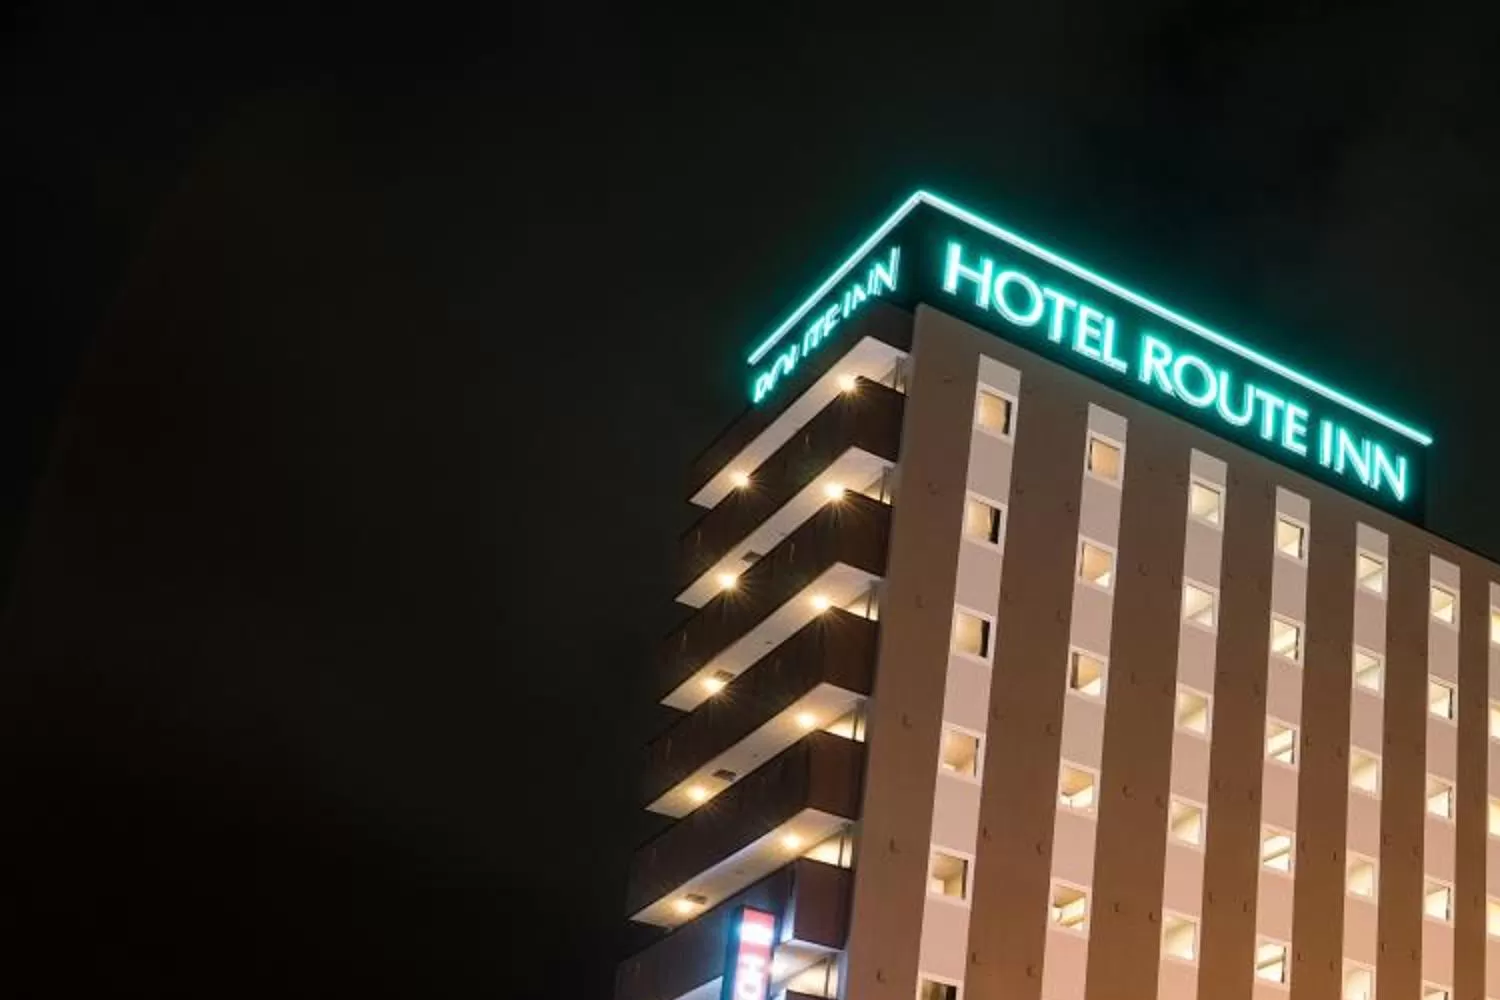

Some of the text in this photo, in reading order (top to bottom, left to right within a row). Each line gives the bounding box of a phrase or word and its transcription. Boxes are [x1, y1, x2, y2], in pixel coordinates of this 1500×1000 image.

[942, 240, 1408, 502] HOTEL ROUTE INN
